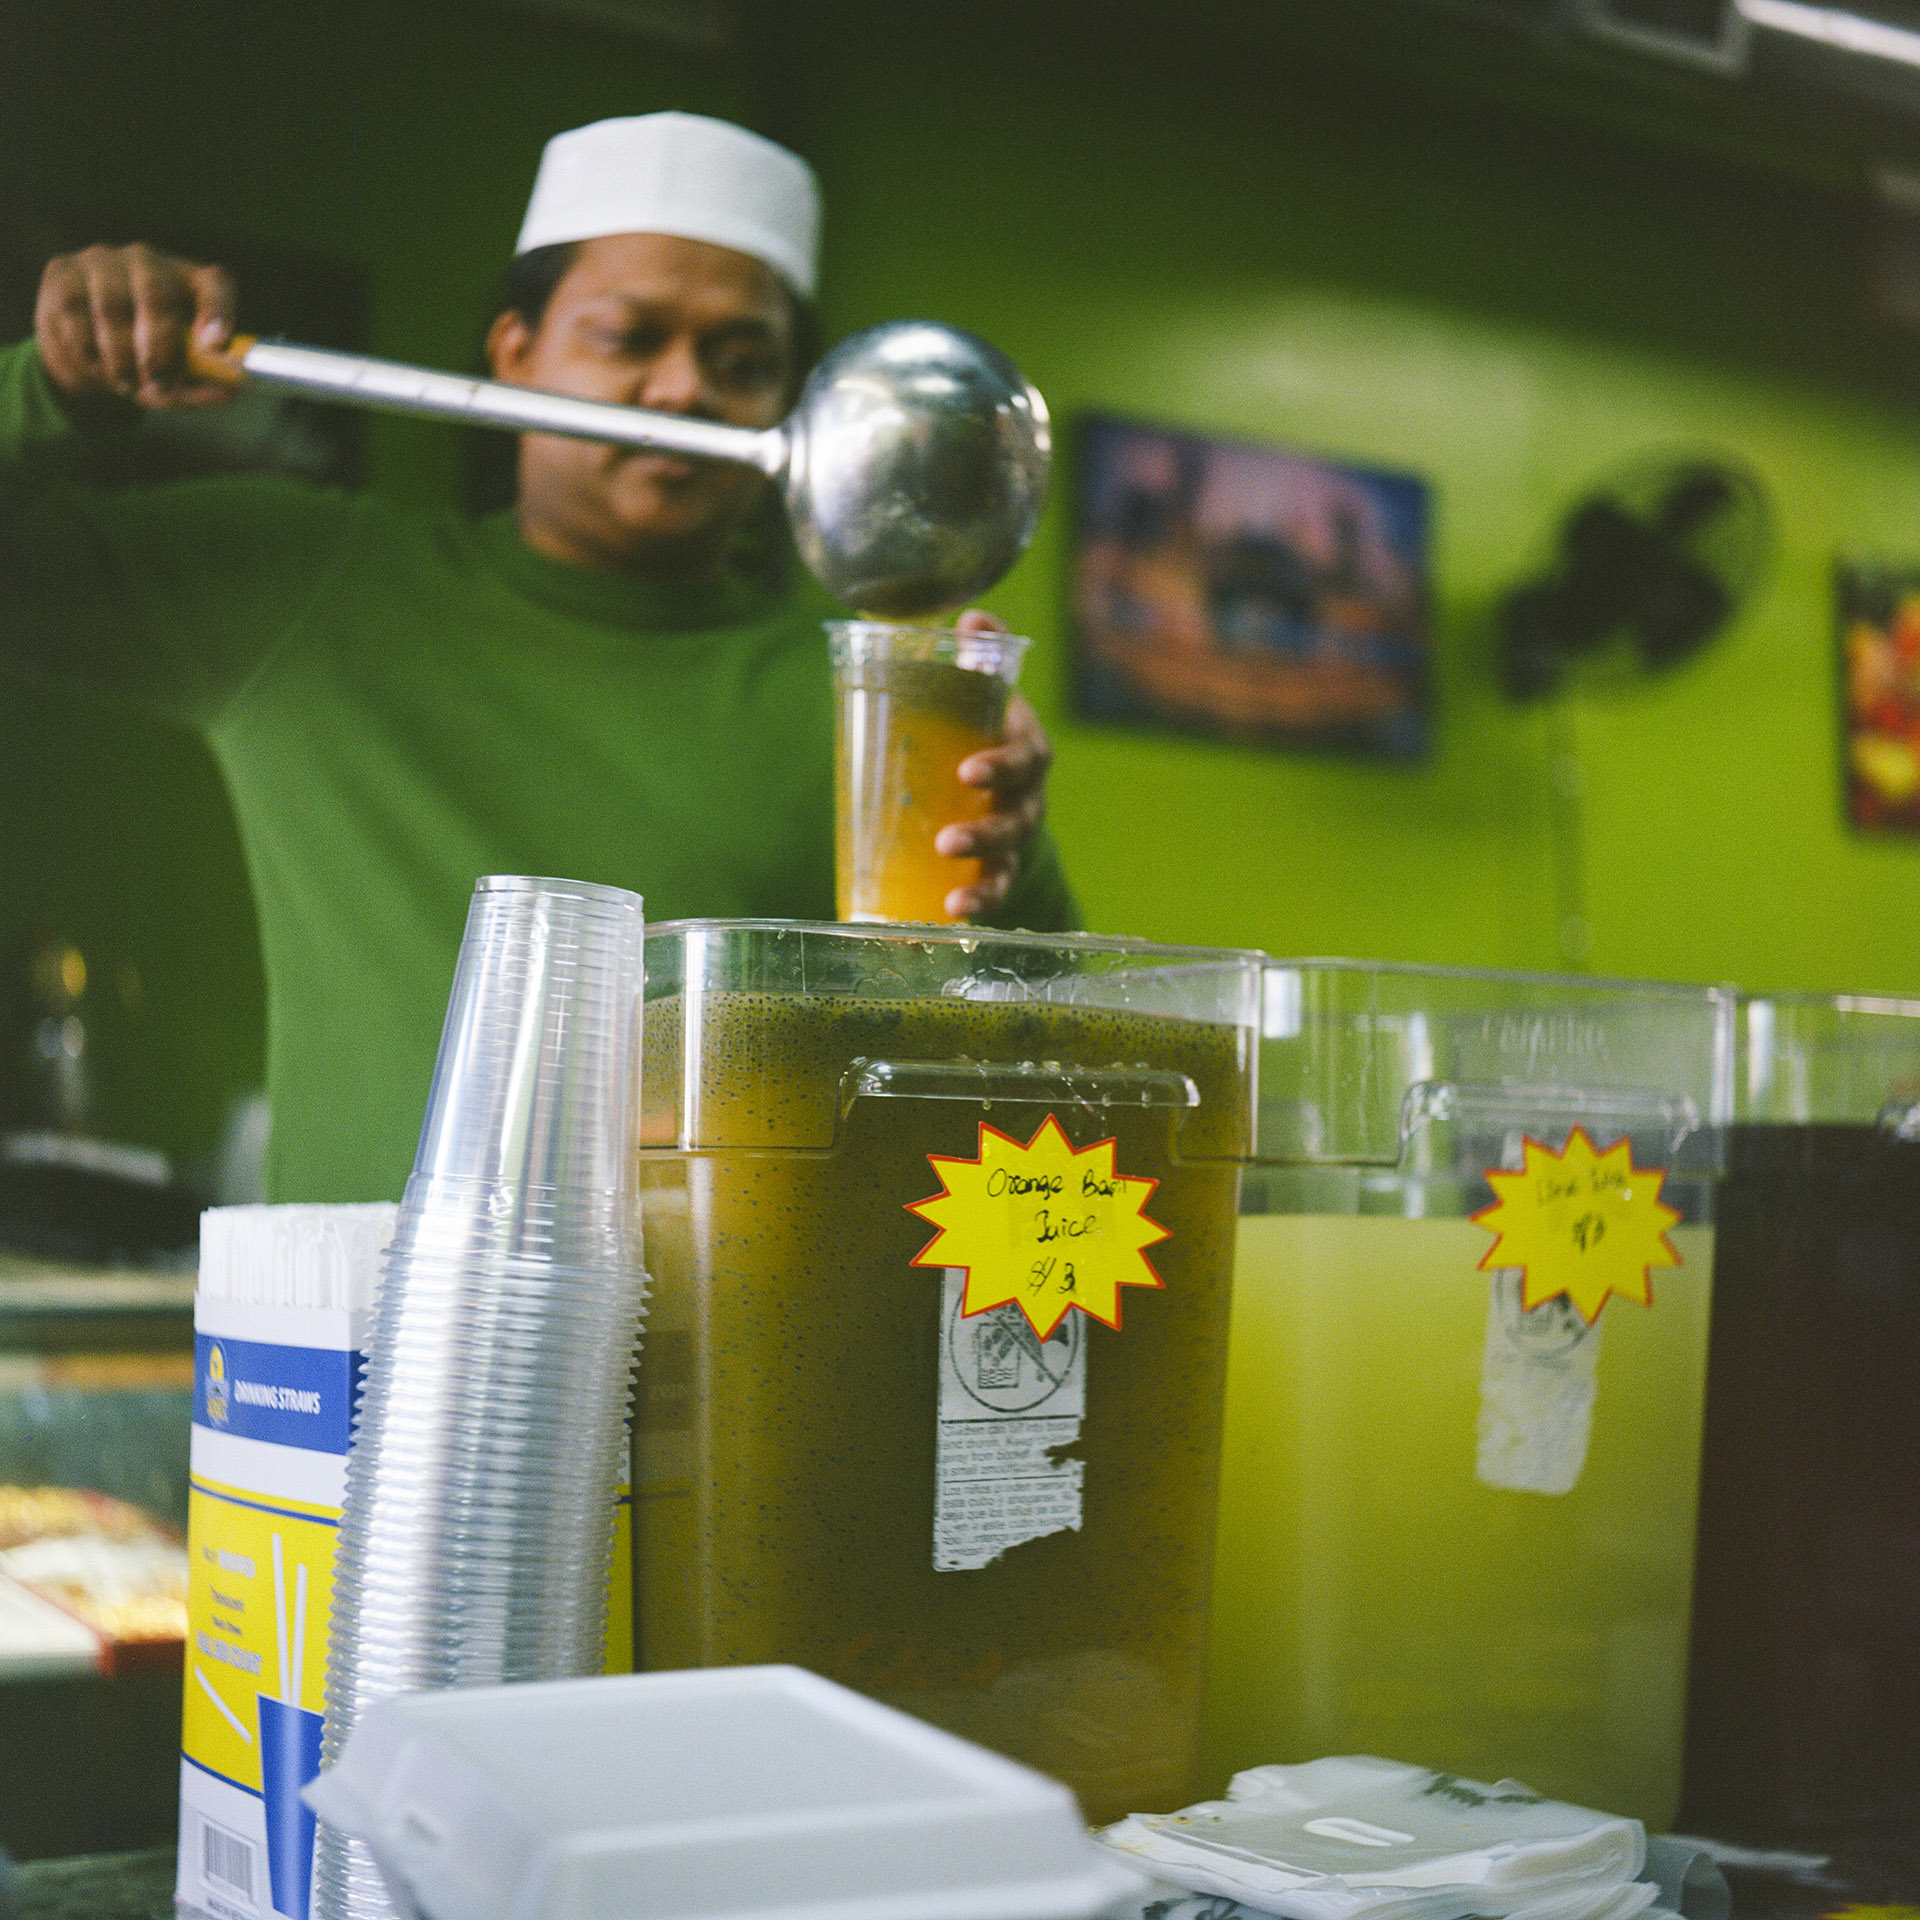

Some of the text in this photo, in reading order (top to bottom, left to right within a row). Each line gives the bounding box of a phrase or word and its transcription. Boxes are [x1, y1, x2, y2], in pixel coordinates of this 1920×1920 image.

[987, 1168, 1064, 1200] Orange
[1034, 1210, 1098, 1242] Juice
[234, 1379, 321, 1414] DRINKING STRAWS
